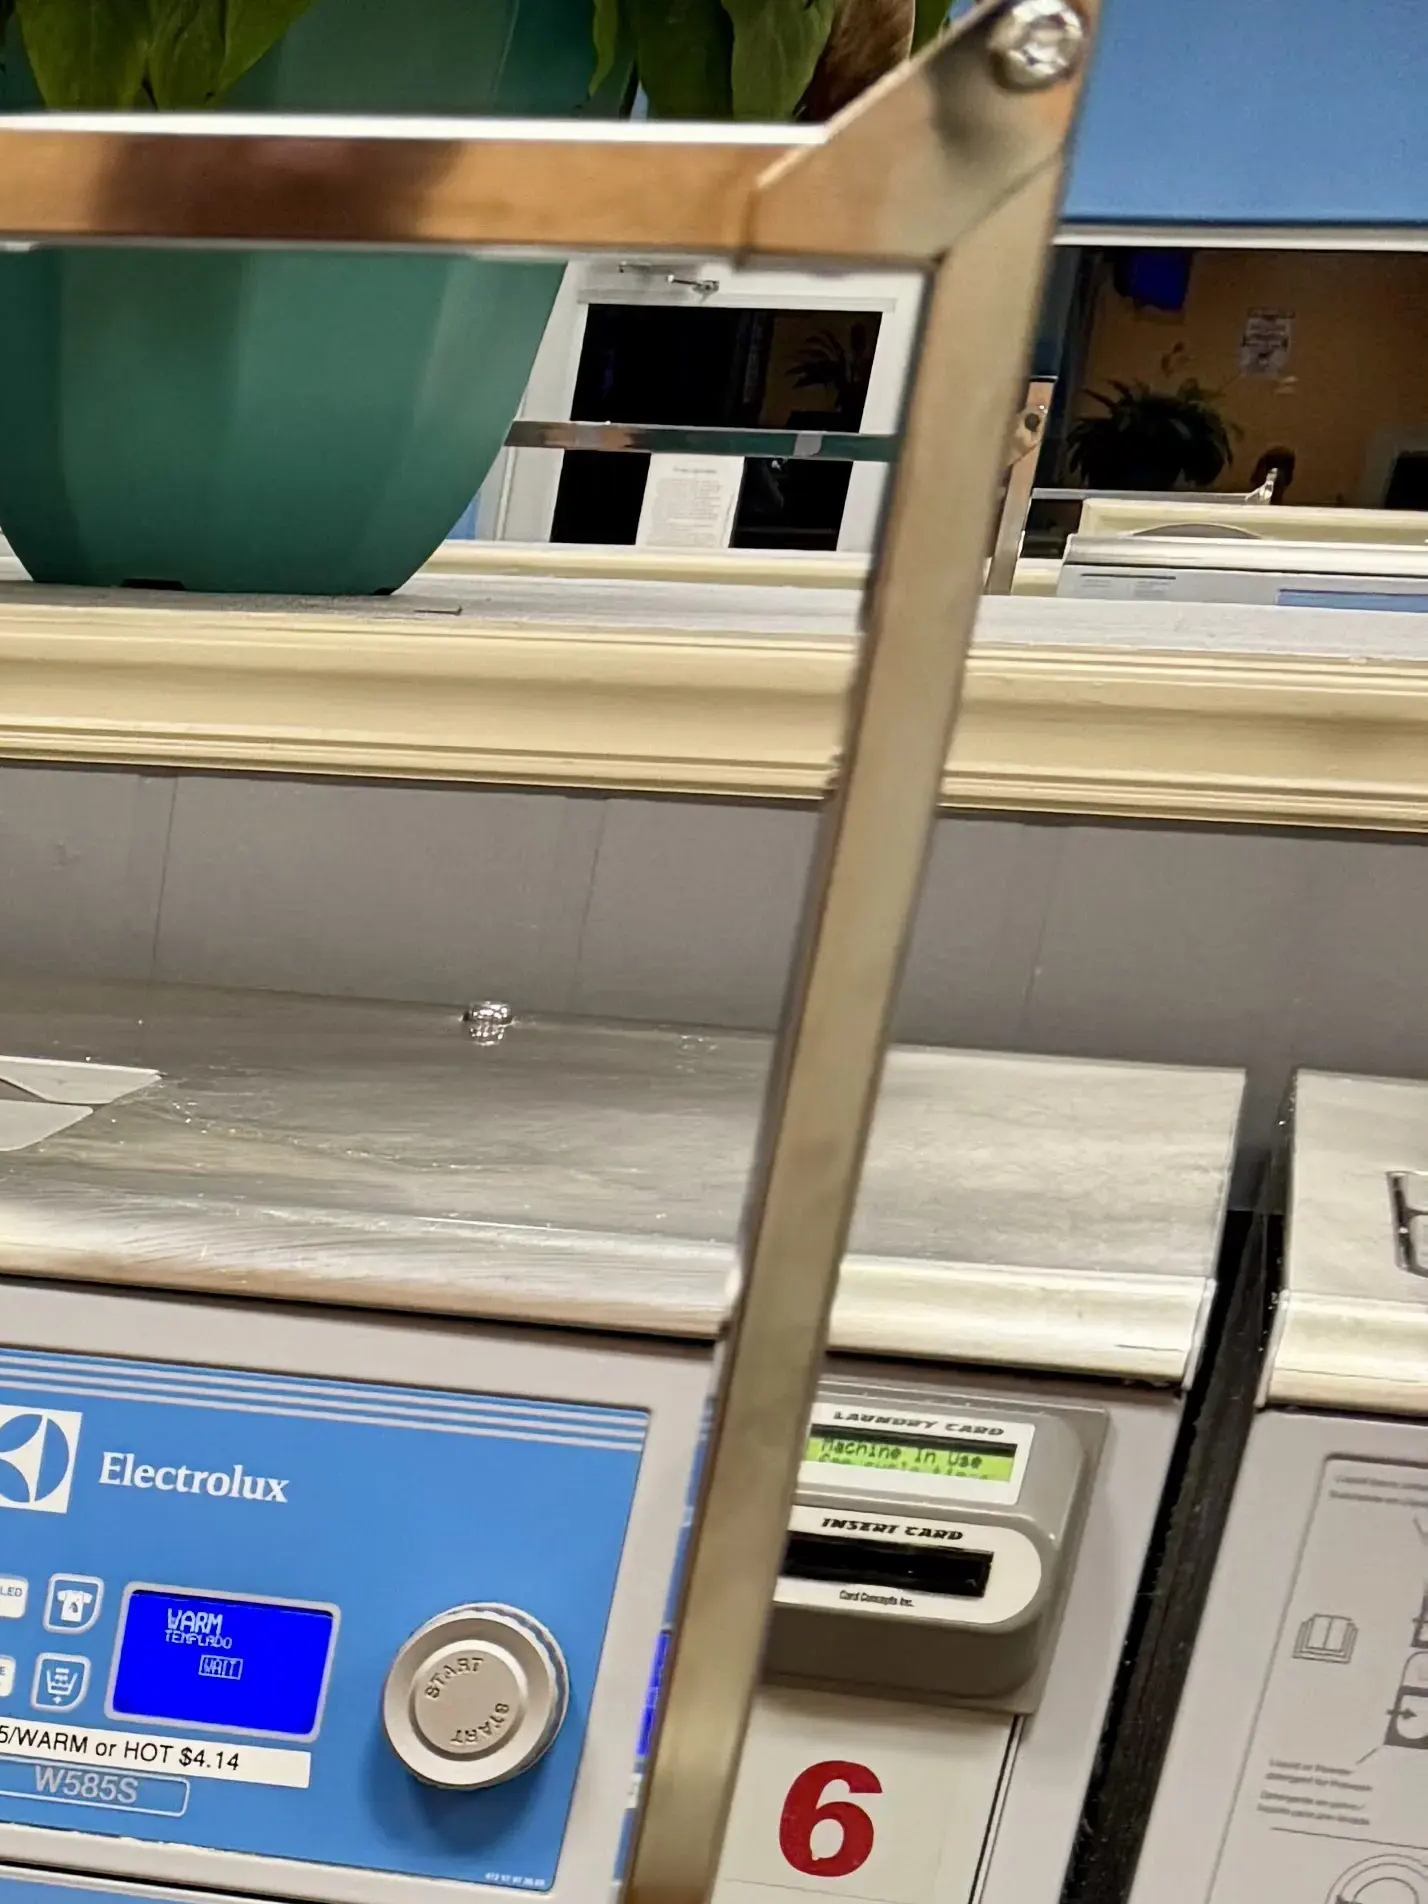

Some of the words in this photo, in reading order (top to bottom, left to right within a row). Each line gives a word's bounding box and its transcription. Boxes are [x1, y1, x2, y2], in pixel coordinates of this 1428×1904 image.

[833, 1411, 939, 1429] LAUNDRY
[945, 1422, 1005, 1436] CARD
[821, 1437, 901, 1460] Machine
[914, 1448, 936, 1464] In
[948, 1453, 983, 1469] Use
[98, 1451, 290, 1503] Electrolux
[821, 1517, 899, 1534] INSERT
[904, 1526, 964, 1541] CARD
[840, 1590, 860, 1602] Card
[167, 1608, 223, 1635] WARM
[204, 1658, 237, 1676] WAIT
[425, 1657, 484, 1699] START
[450, 1703, 510, 1744] START
[95, 1741, 116, 1757] or
[123, 1741, 174, 1764] HOT
[178, 1746, 240, 1771] $4.14
[34, 1765, 139, 1804] W585S
[778, 1760, 883, 1877] 6
